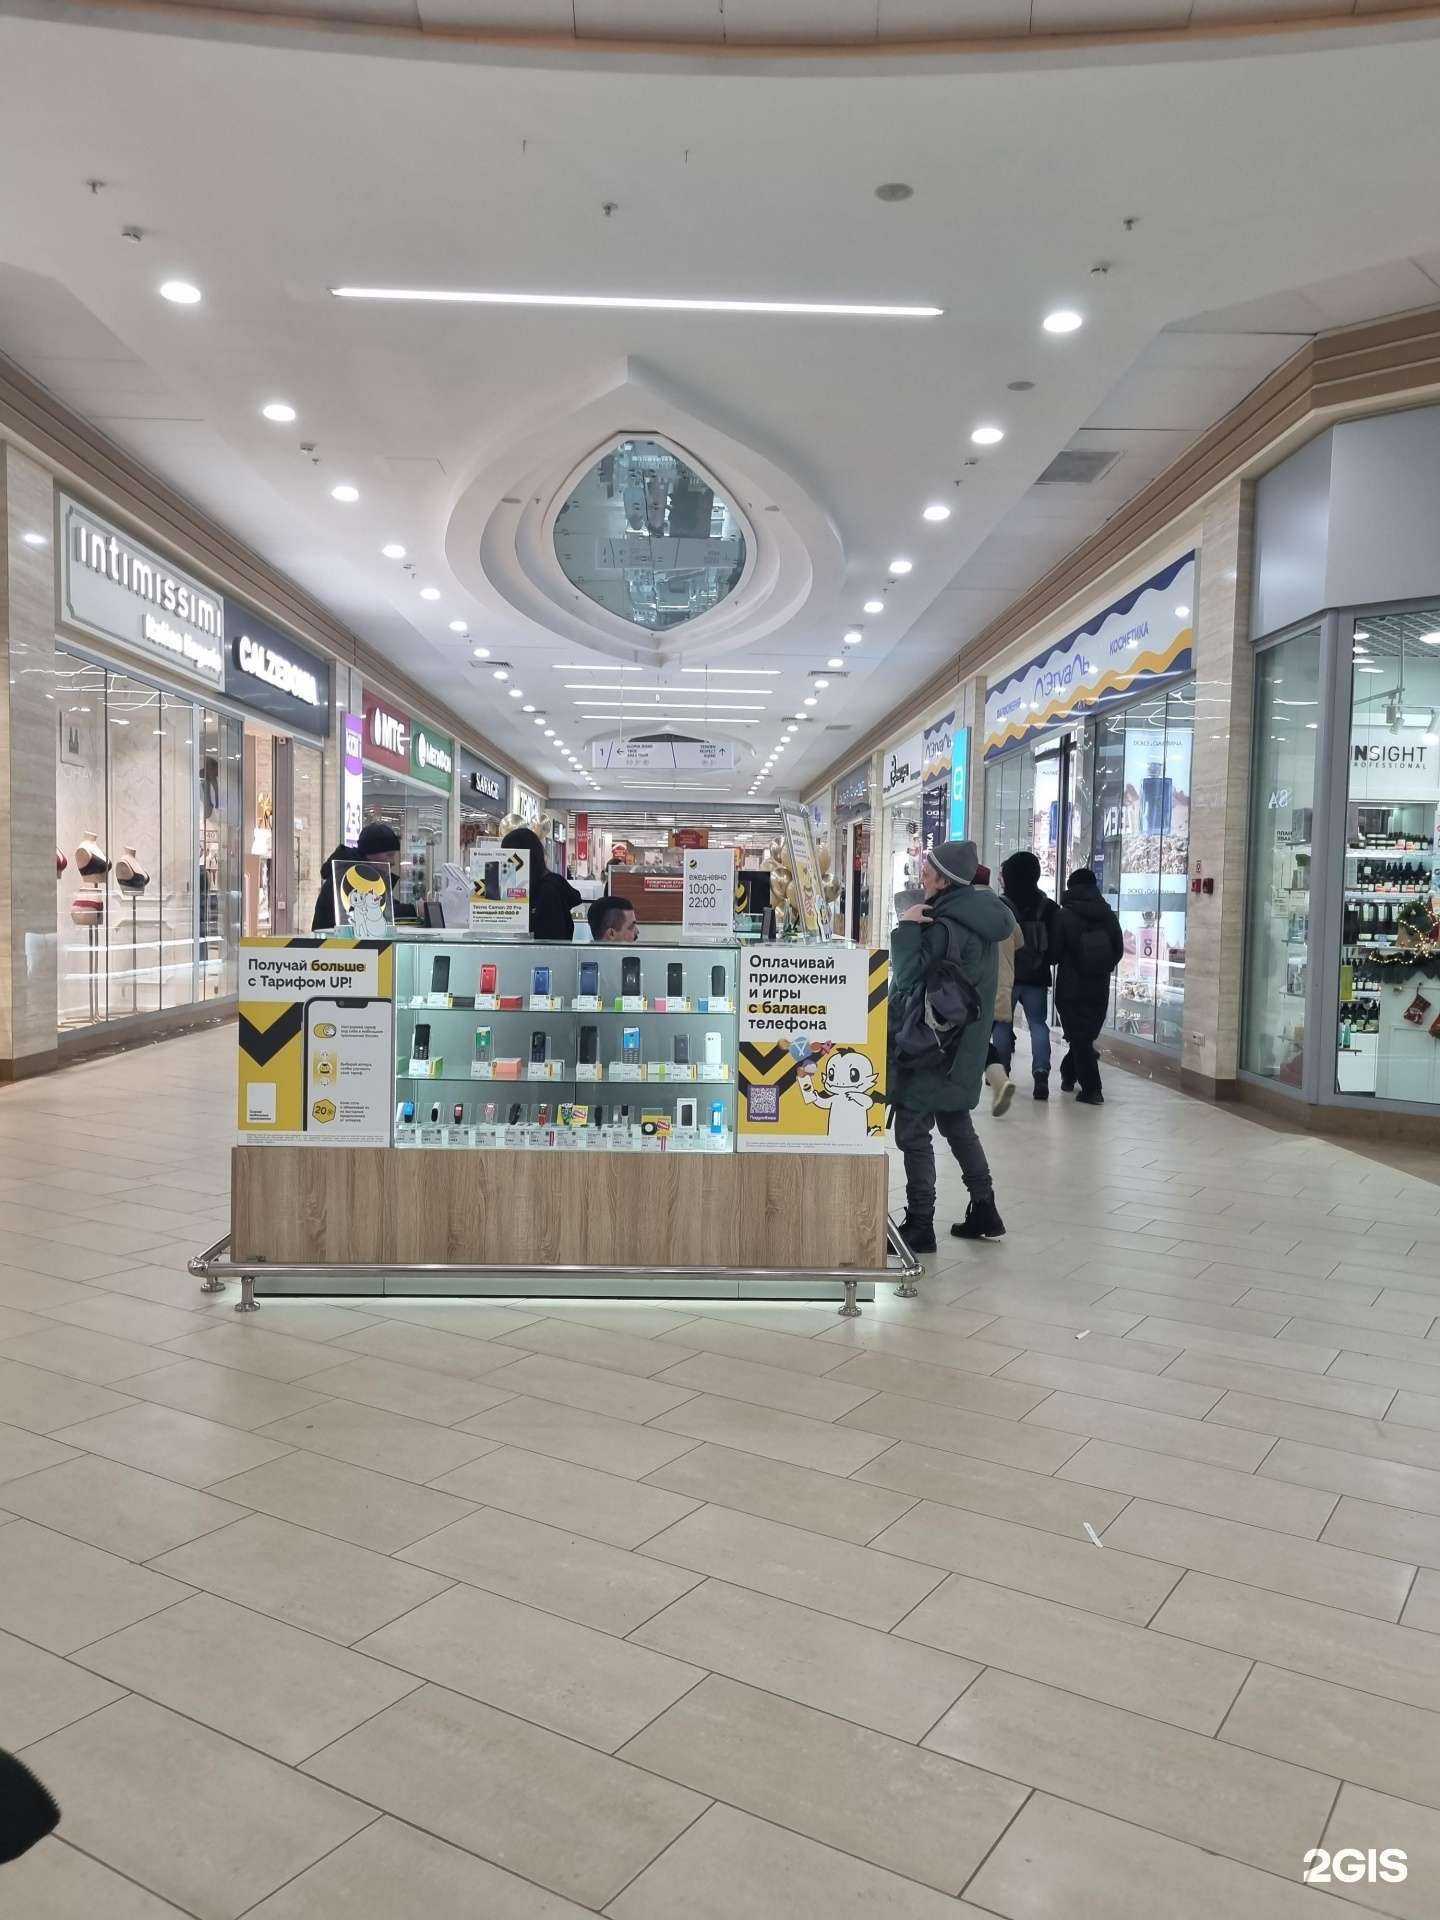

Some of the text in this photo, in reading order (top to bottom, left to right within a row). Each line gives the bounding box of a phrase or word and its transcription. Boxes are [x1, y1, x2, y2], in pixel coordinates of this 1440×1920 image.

[1109, 621, 1149, 657] КОСМЕТИКА
[382, 712, 405, 756] МТС
[688, 897, 716, 908] 22:00
[248, 958, 366, 973] Получай больше
[749, 954, 835, 969] Оплачивай
[247, 975, 353, 990] с Тарифом UP!
[749, 972, 847, 987] приложения
[749, 989, 801, 1002] и игры
[748, 1000, 827, 1015] с баланса
[748, 1018, 827, 1033] телефона
